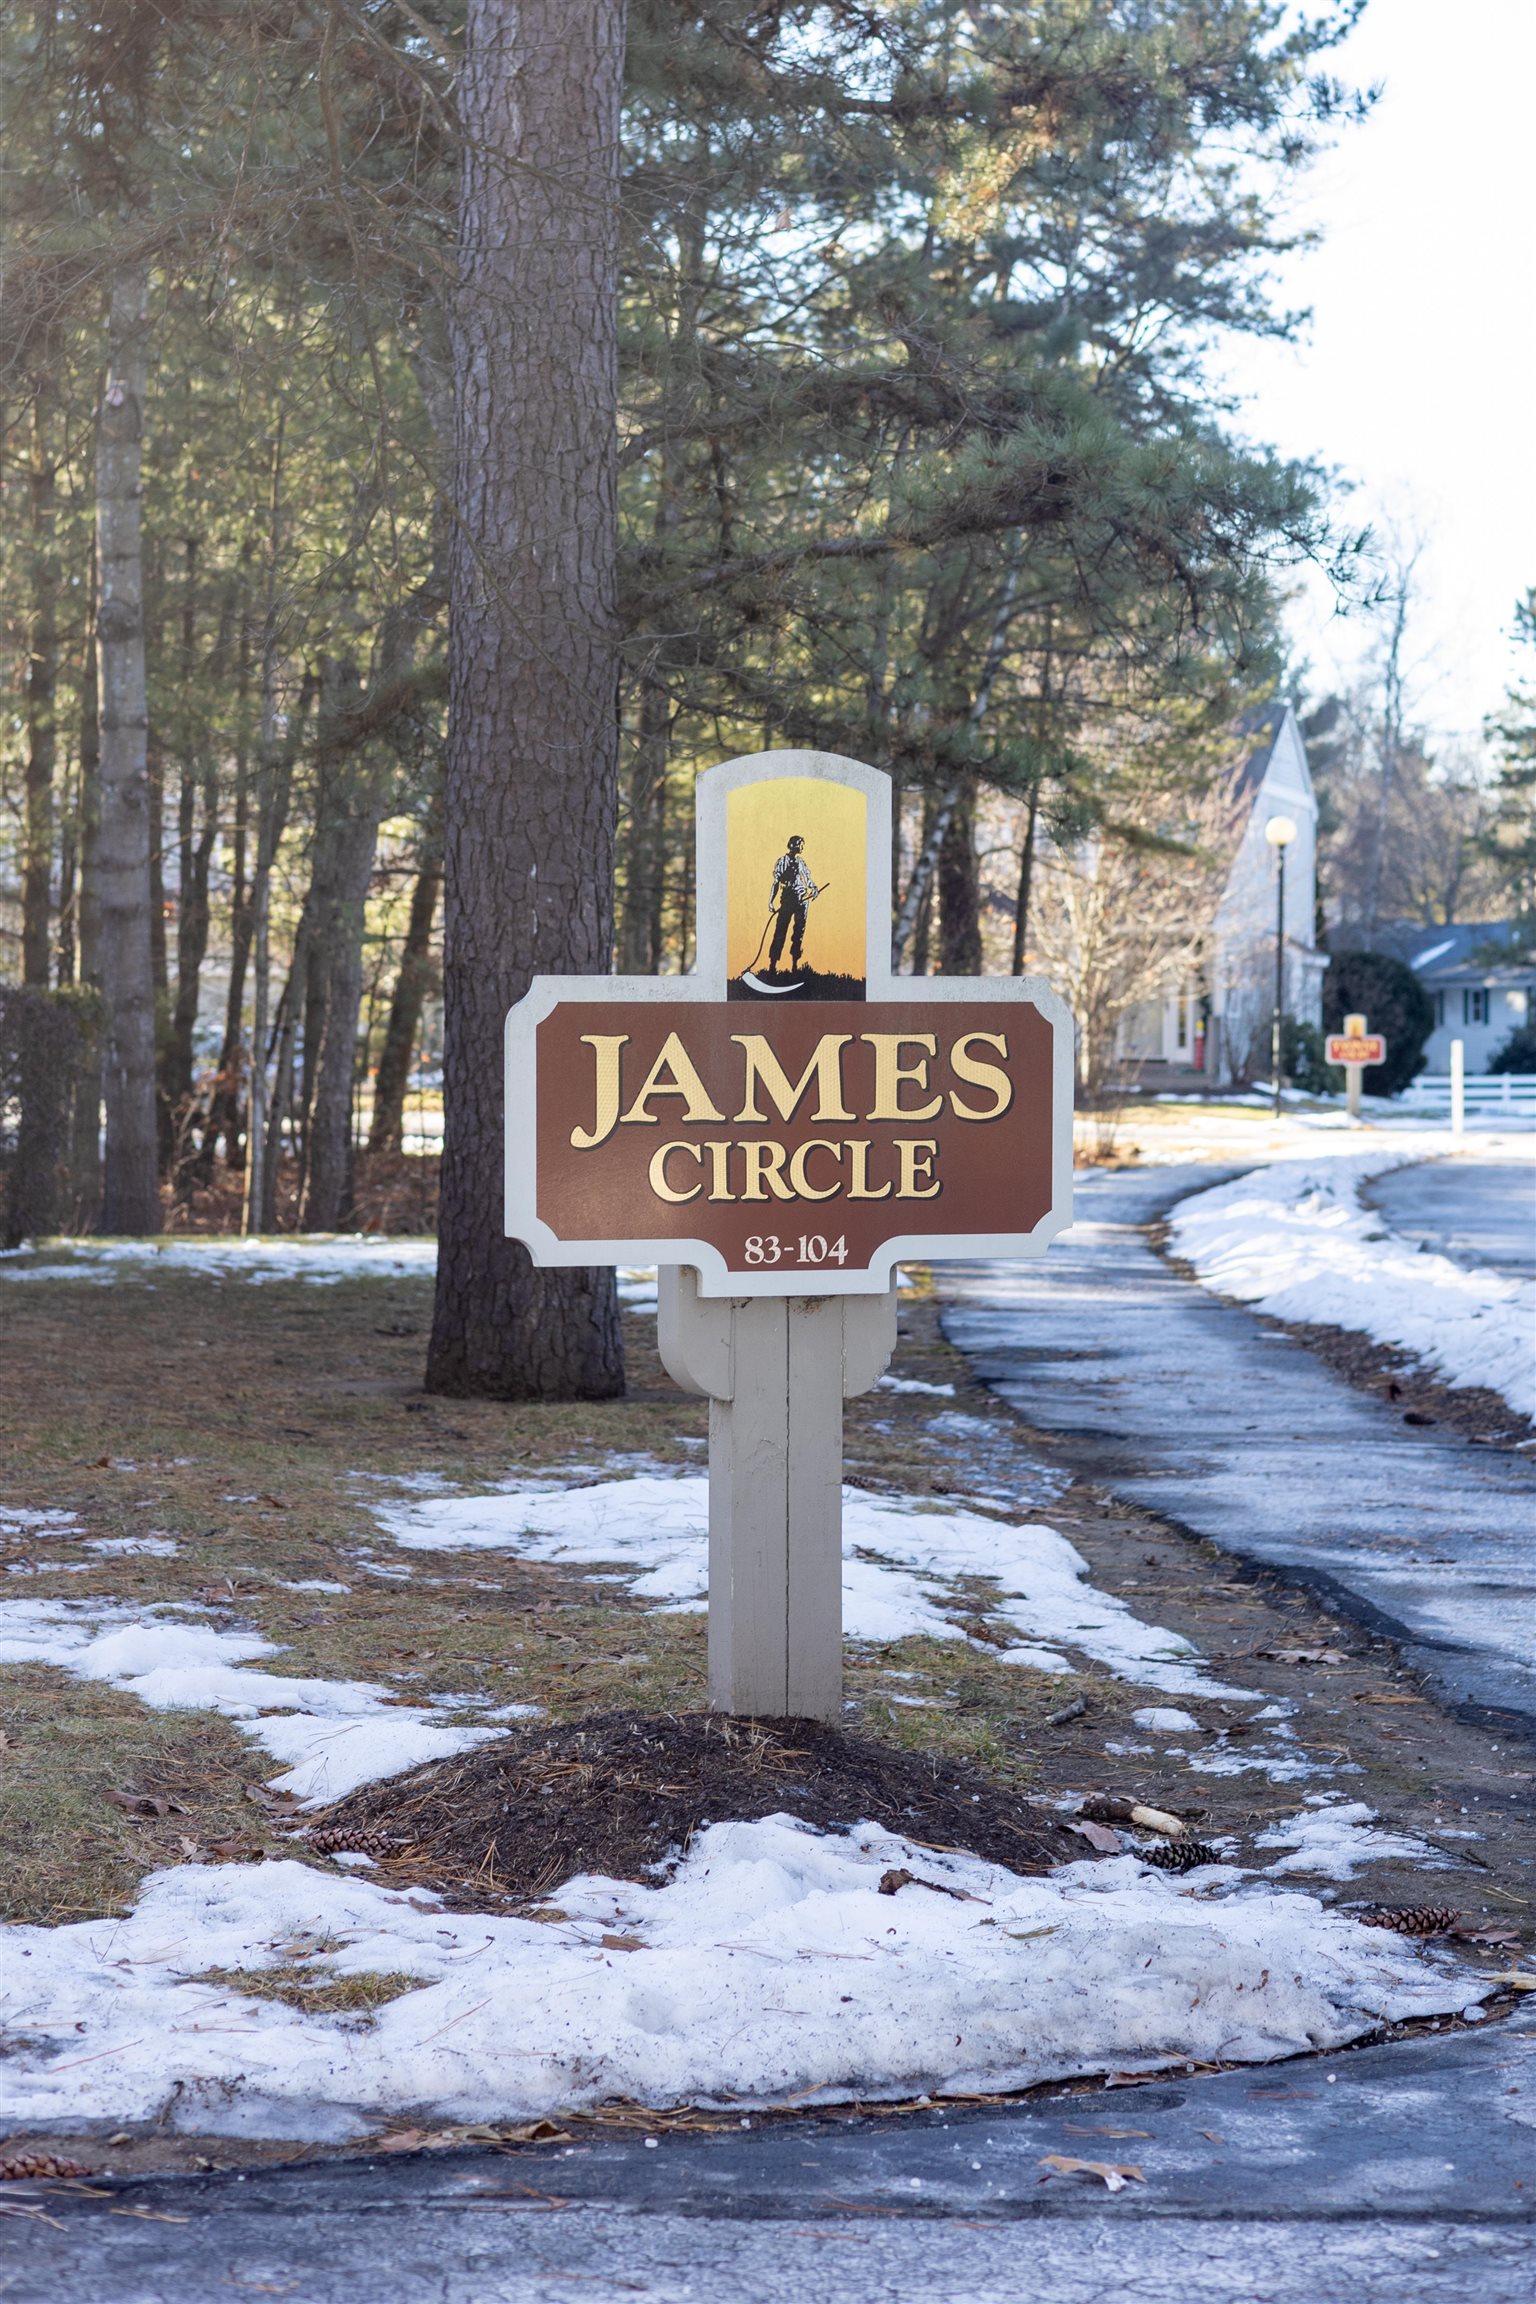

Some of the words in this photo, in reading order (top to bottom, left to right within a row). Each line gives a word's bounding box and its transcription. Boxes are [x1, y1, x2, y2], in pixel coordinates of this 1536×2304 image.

[570, 1031, 1014, 1149] JAMES
[648, 1139, 942, 1203] CIRCLE
[744, 1234, 849, 1265] 83-104
